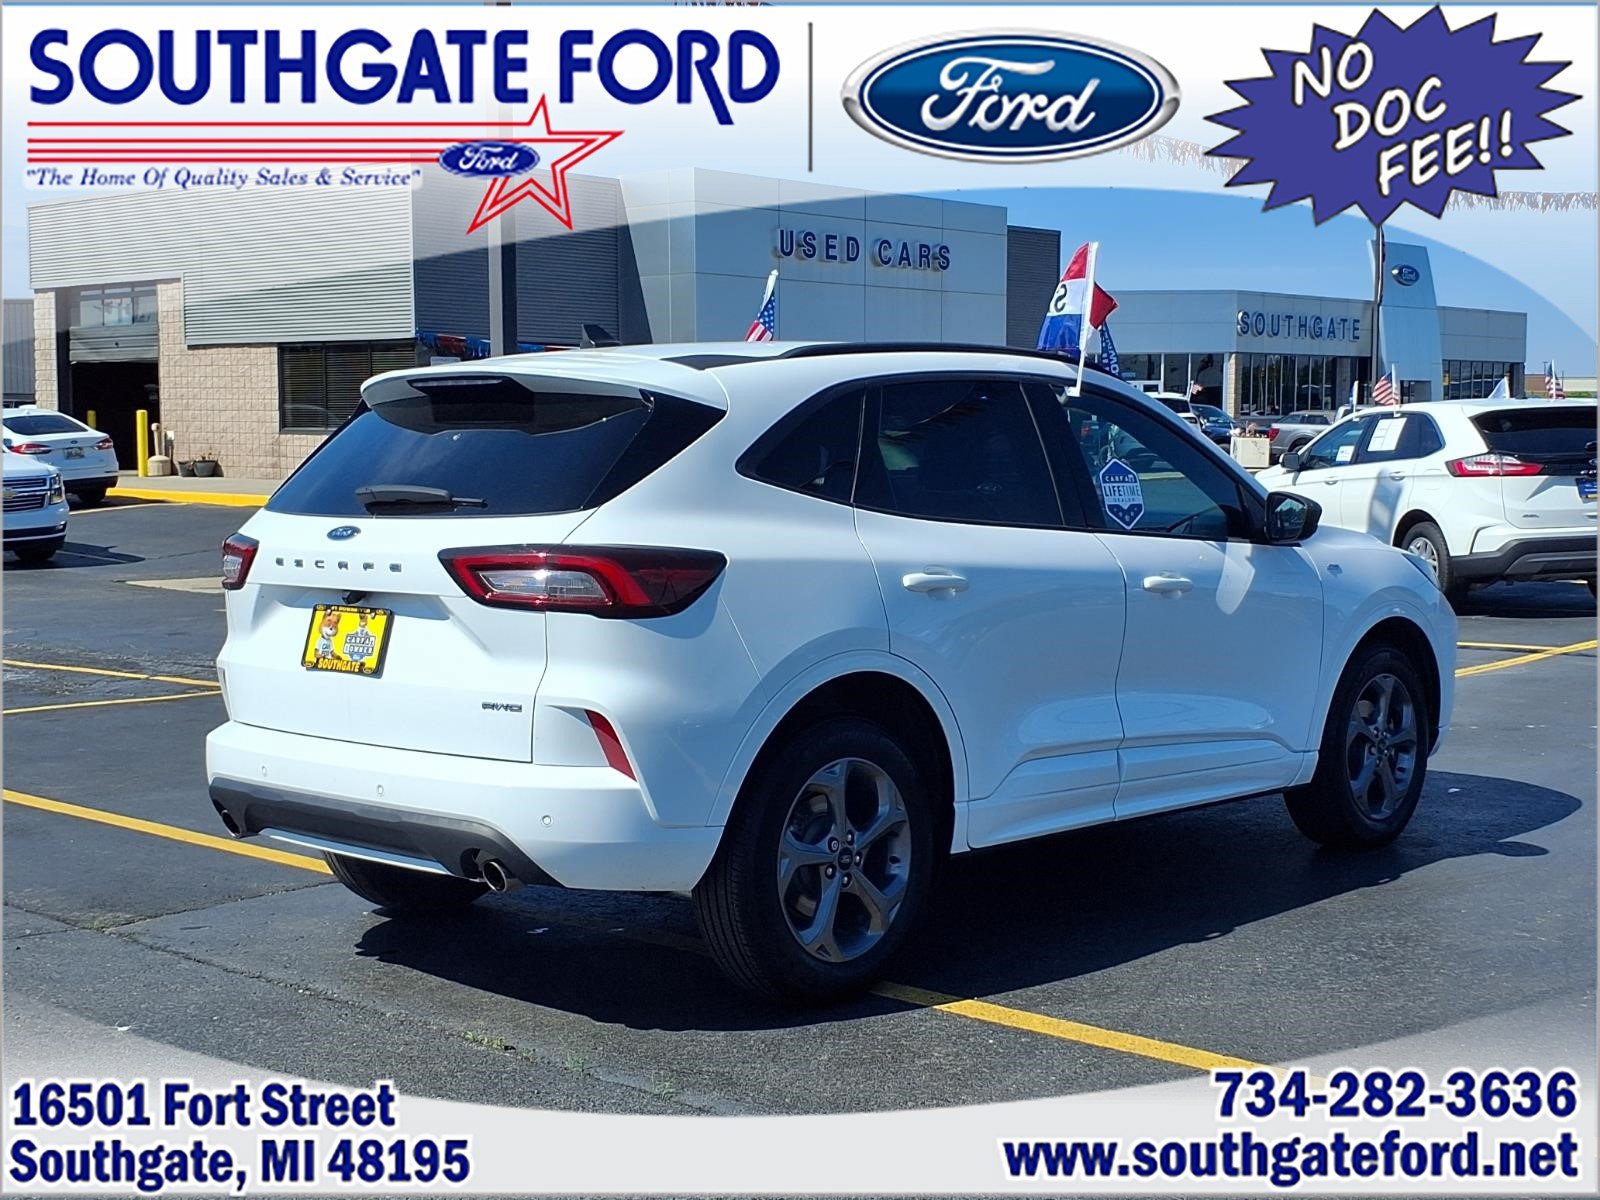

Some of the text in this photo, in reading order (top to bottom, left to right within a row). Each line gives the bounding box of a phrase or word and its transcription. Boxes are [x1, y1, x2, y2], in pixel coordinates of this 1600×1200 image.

[778, 228, 951, 271] USED CARS
[1237, 309, 1361, 341] SOUTHGATE
[1103, 485, 1140, 497] LIFETIME
[275, 557, 402, 573] ESCAPE
[318, 658, 360, 672] SOUTHGATE
[481, 702, 523, 713] AWD
